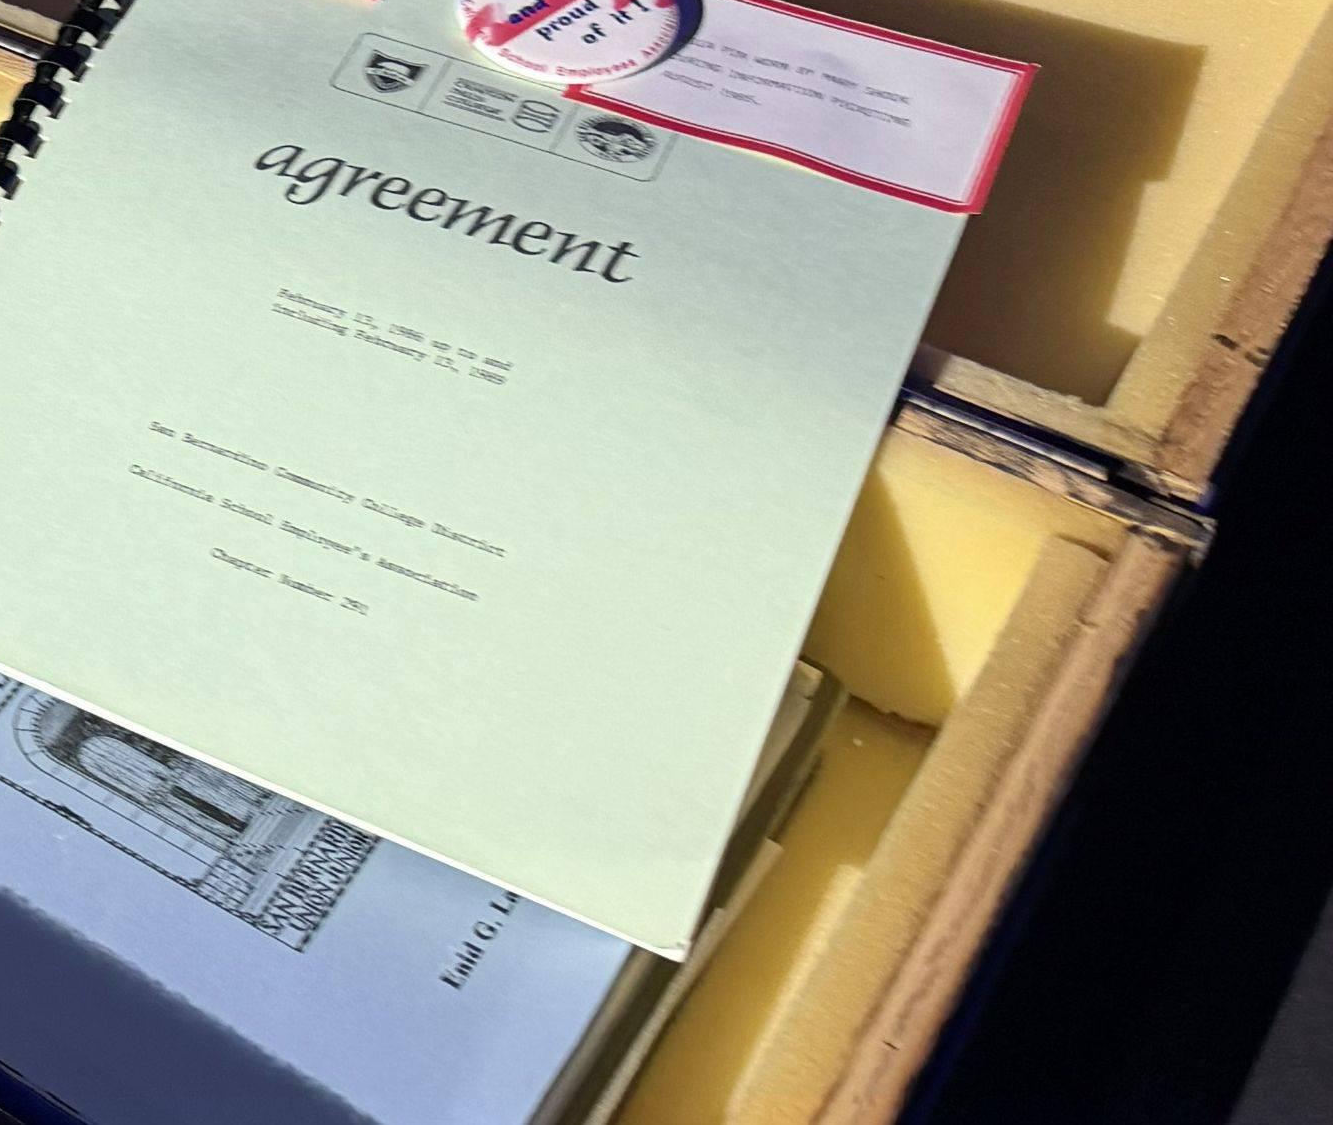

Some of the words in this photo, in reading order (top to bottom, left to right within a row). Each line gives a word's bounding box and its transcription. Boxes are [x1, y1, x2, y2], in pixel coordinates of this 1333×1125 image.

[581, 22, 607, 45] of
[254, 144, 641, 284] agreement
[148, 420, 176, 439] San
[181, 431, 271, 472] Bernardino
[273, 465, 358, 505] Community
[361, 497, 427, 528] College
[430, 521, 508, 558] District
[129, 463, 216, 503] California
[219, 497, 276, 526] School
[375, 556, 481, 603] Association
[209, 546, 275, 580] Chapter
[258, 893, 300, 936] SAN
[288, 880, 338, 932] UNION
